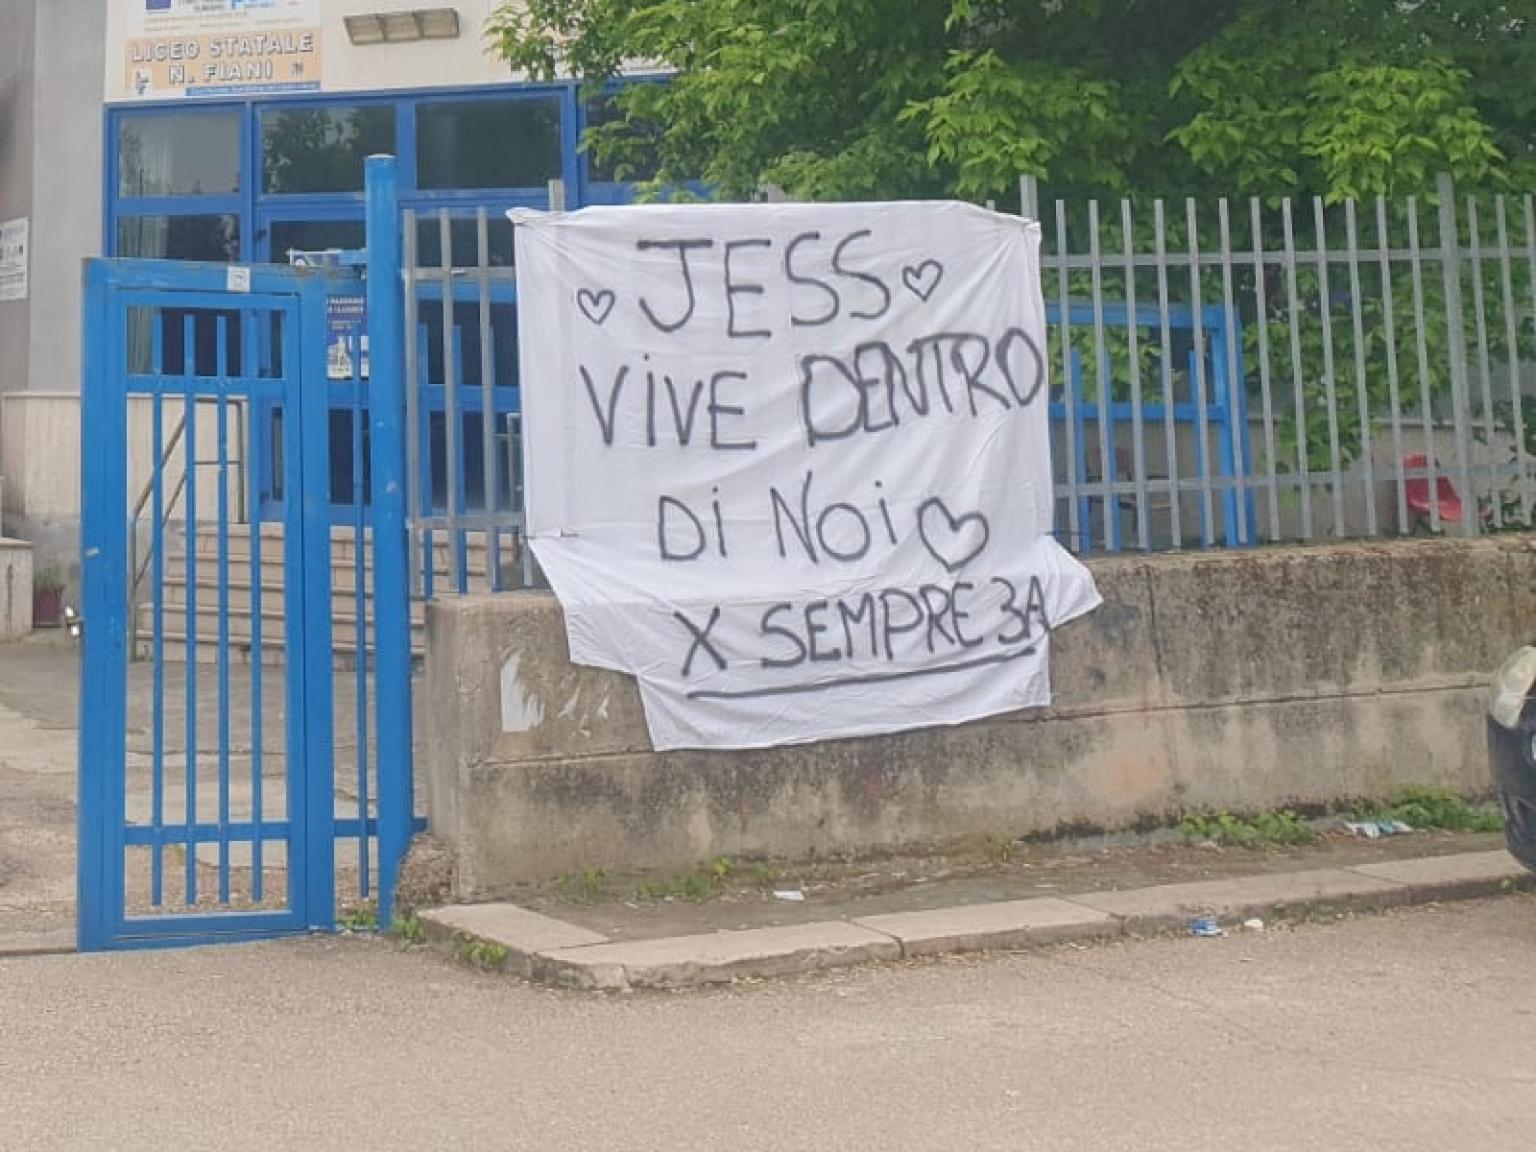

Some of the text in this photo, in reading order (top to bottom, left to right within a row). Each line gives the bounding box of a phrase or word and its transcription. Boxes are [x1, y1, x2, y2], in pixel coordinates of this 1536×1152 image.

[132, 31, 314, 62] LICEO STATALE
[169, 64, 196, 85] N.
[204, 60, 274, 82] FIANI
[636, 229, 891, 338] JESS
[800, 327, 1042, 448] DENTRO
[672, 605, 728, 678] X
[760, 581, 984, 668] SEMPRE
